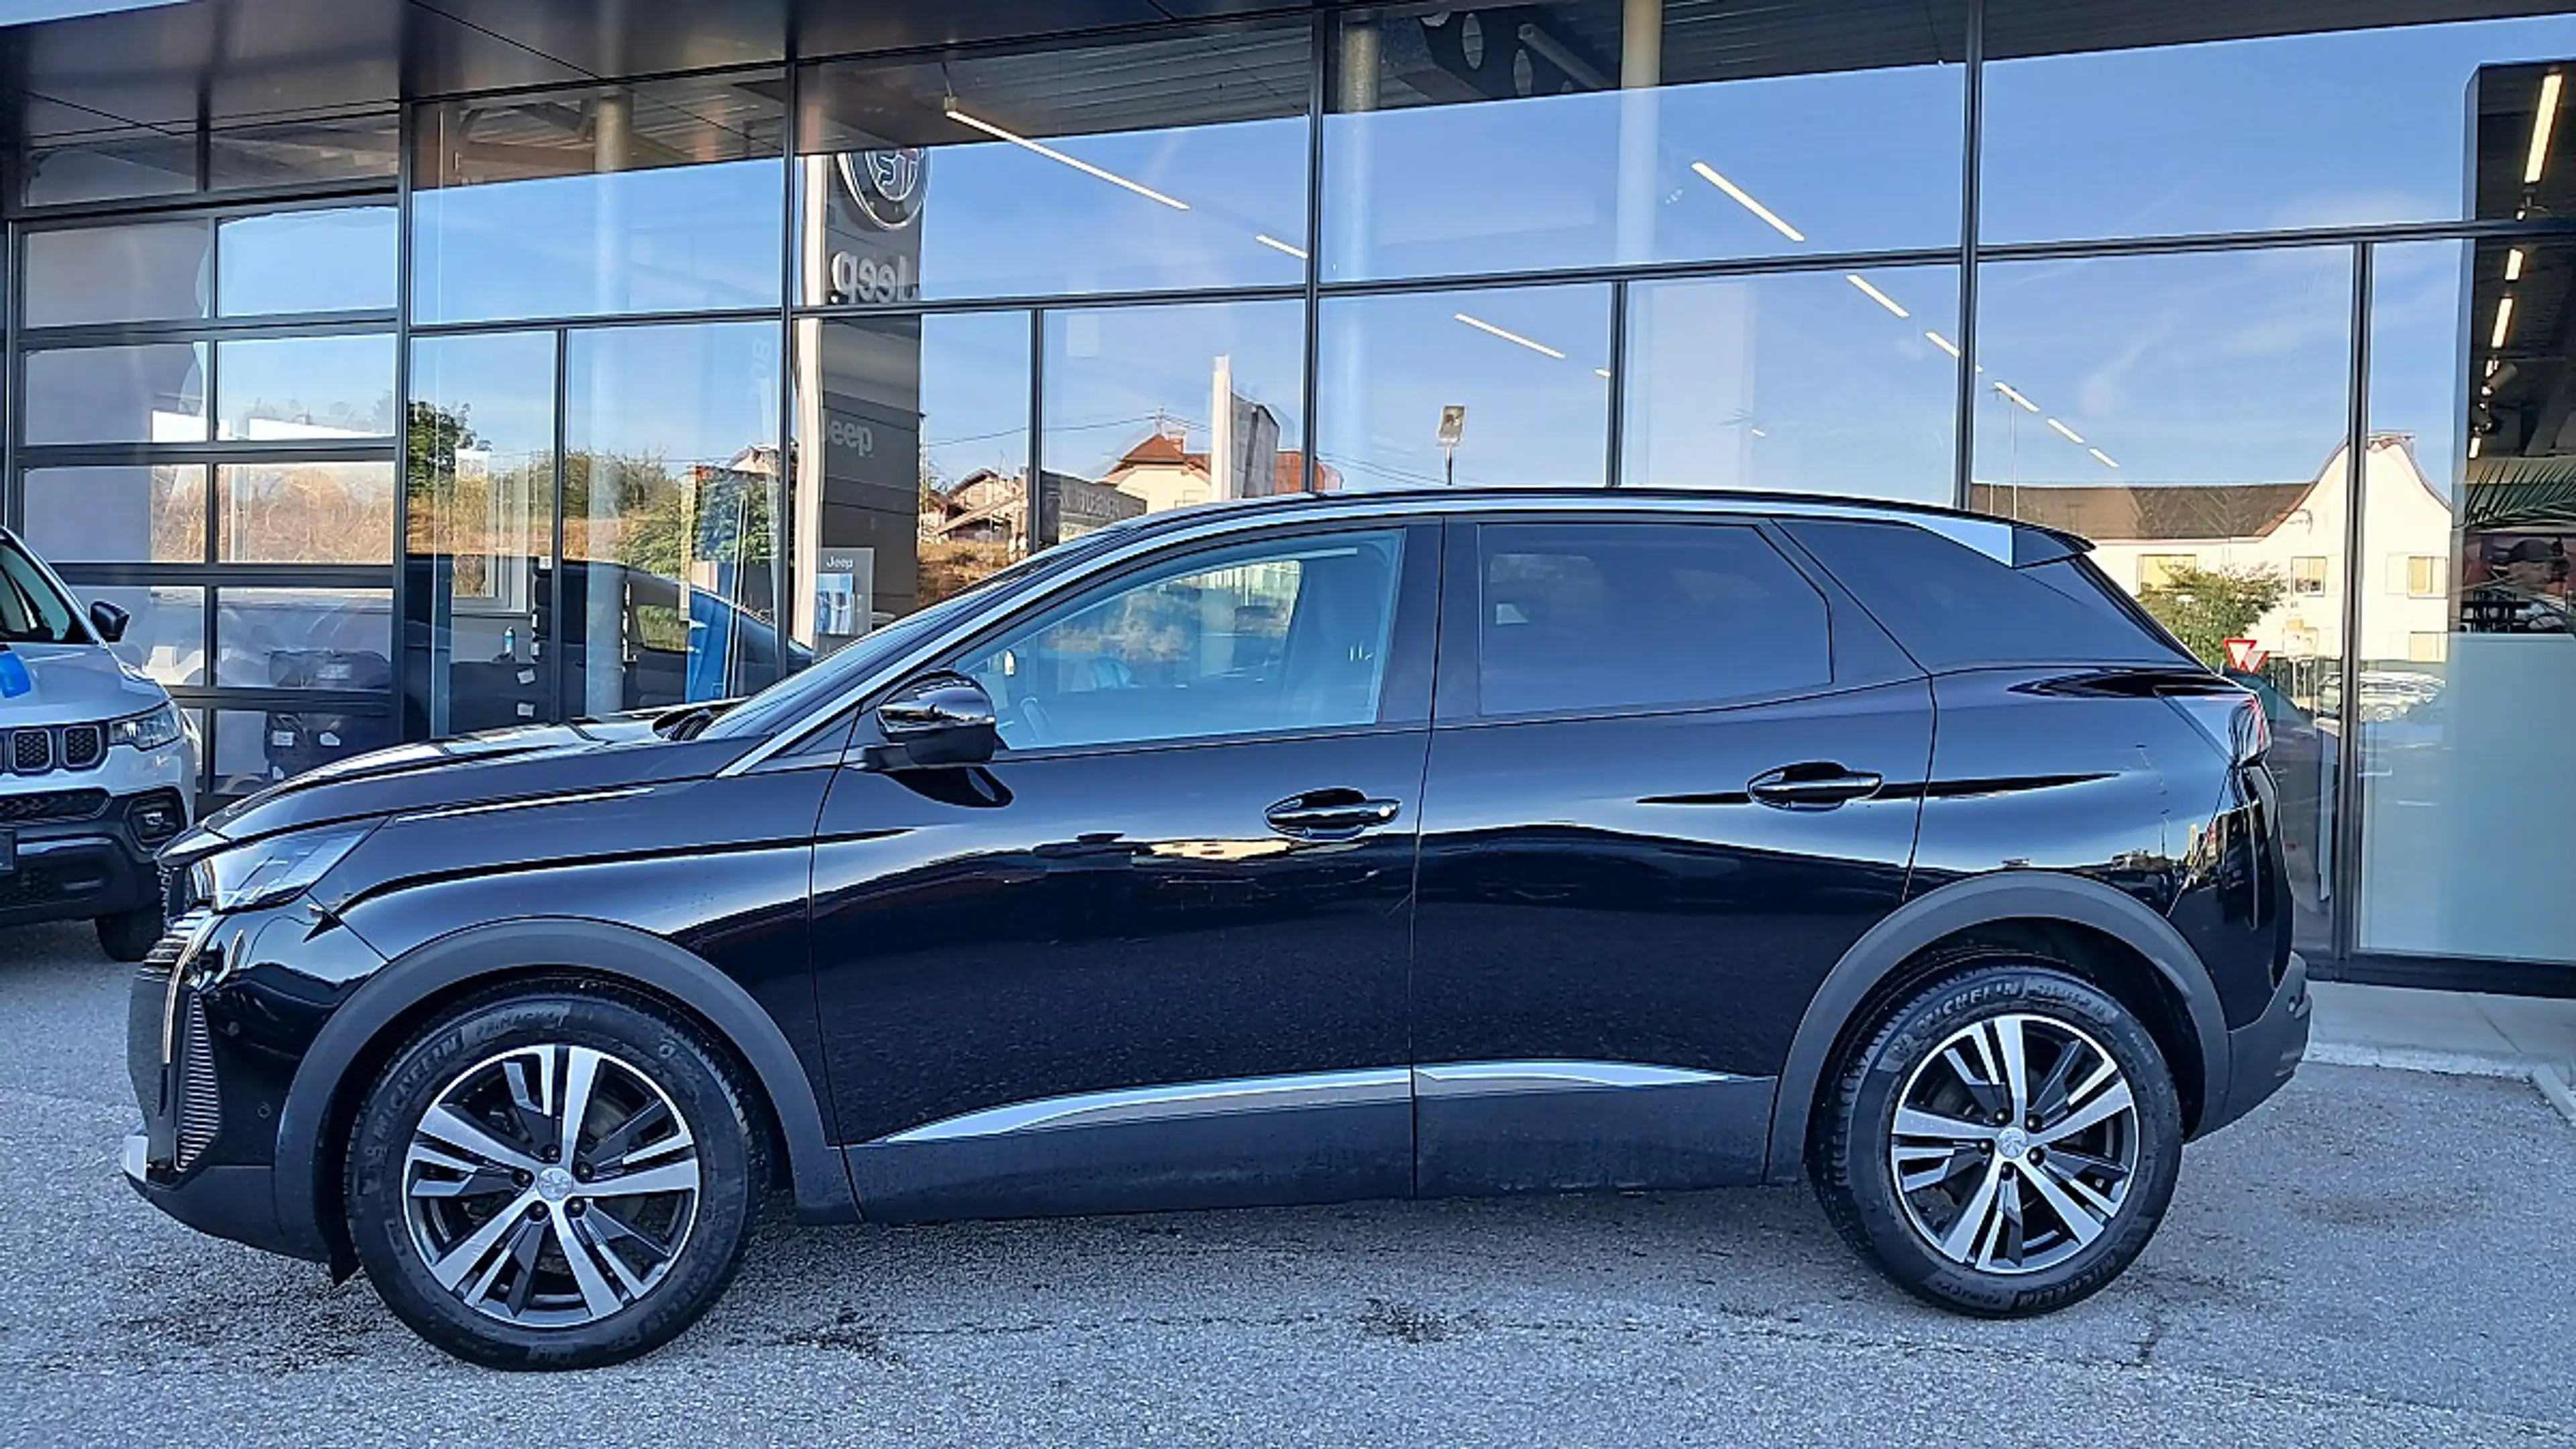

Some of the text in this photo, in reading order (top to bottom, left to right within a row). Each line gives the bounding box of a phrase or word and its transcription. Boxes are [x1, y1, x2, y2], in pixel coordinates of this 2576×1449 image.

[829, 419, 873, 457] eep
[826, 555, 853, 570] Jeep
[1917, 981, 2019, 1030] MICHELIN
